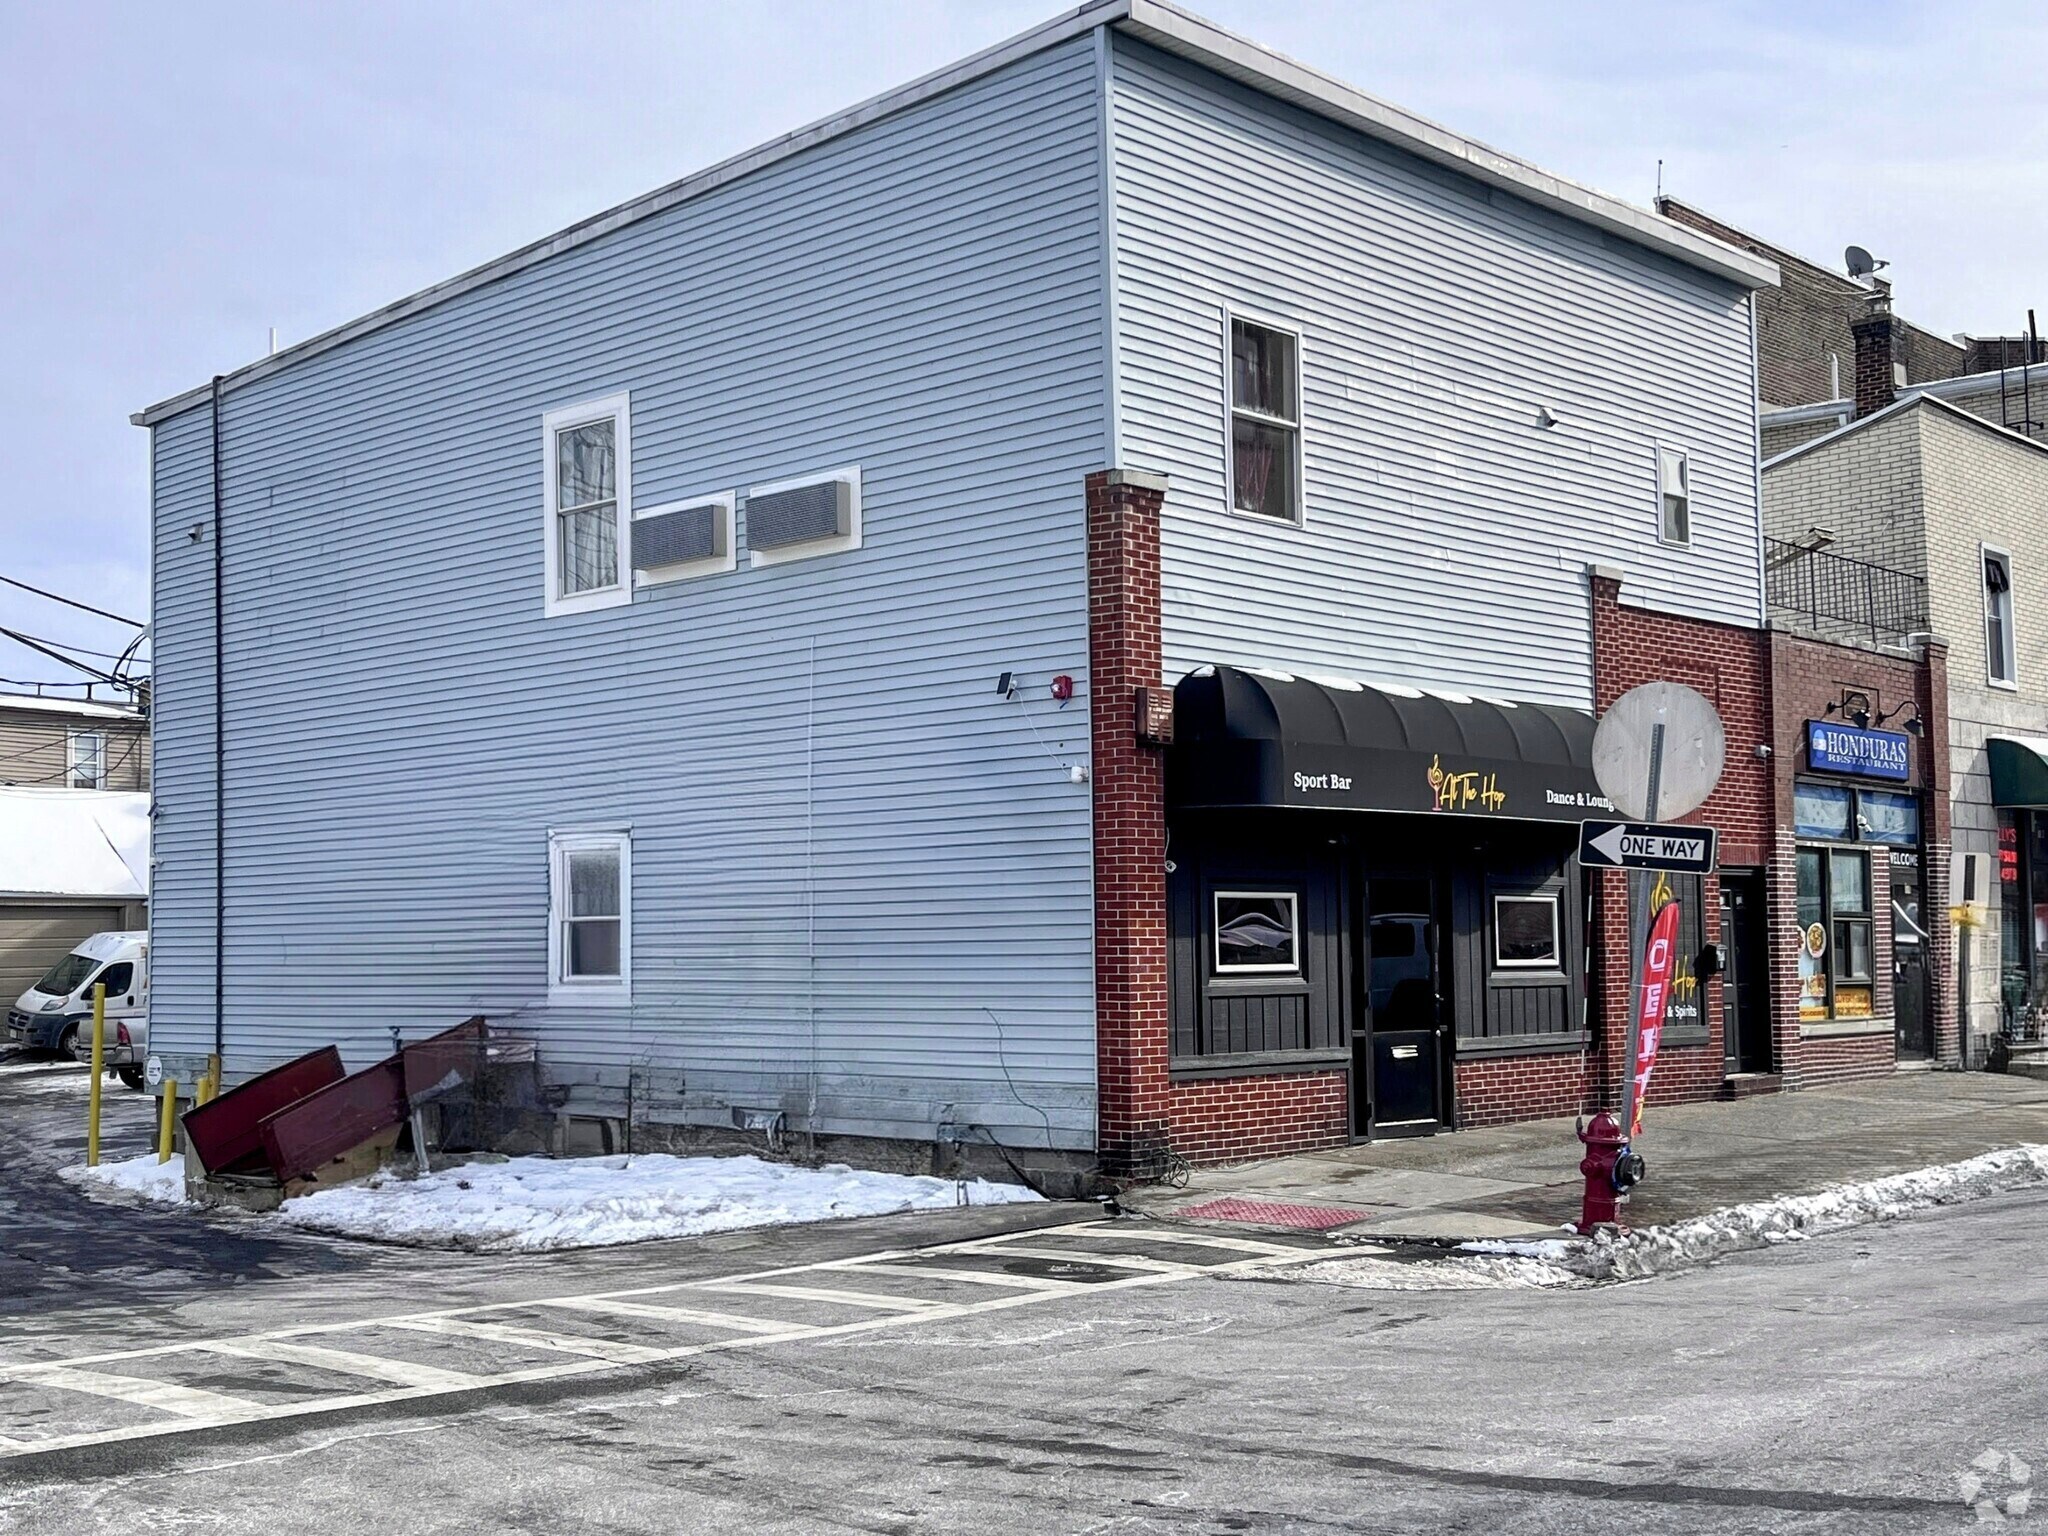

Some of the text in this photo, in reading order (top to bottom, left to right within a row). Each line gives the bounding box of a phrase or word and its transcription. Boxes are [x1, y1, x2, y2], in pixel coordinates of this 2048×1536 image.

[1827, 731, 1907, 763] HONDURAS
[1827, 754, 1907, 771] RESTAURANT
[1294, 771, 1352, 792] Sport Bar
[1439, 772, 1506, 812] At The Hop
[1546, 789, 1615, 812] Dance & Loung
[1620, 836, 1700, 858] ONE WAY
[1672, 955, 1698, 1002] Hop
[1674, 1004, 1697, 1019] Spirits
